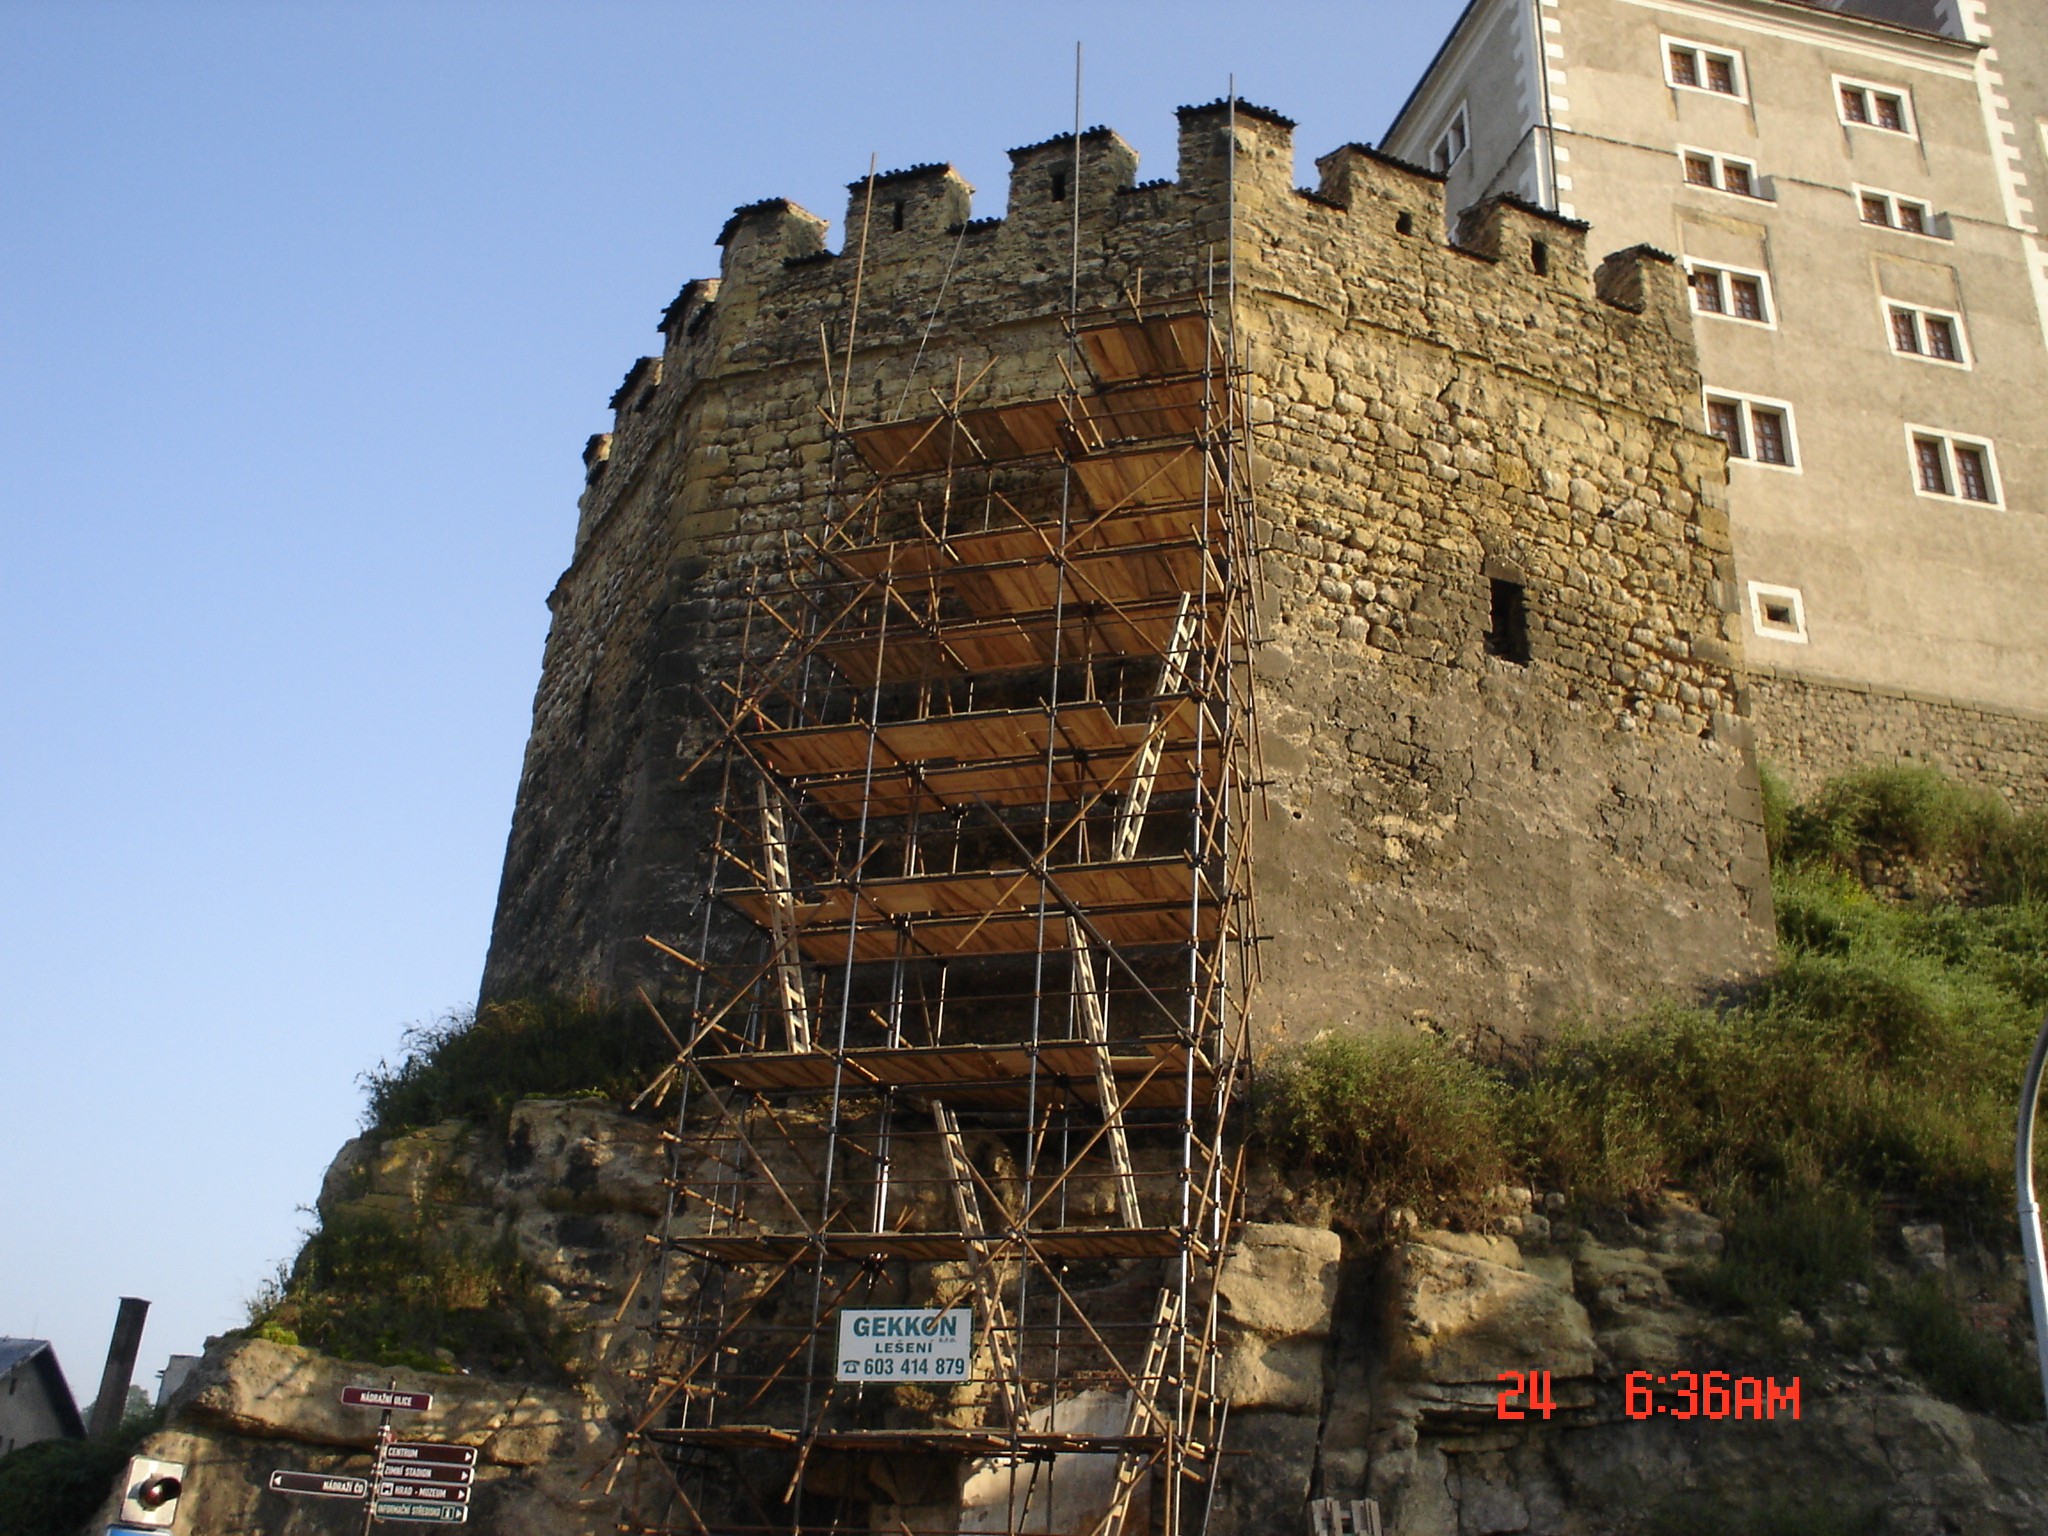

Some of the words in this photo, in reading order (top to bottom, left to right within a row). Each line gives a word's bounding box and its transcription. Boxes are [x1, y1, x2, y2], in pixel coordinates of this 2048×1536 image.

[853, 1316, 957, 1337] GEKKON
[875, 1339, 933, 1353] LEŠENÍ
[864, 1358, 894, 1375] 603
[900, 1358, 928, 1375] 414
[935, 1358, 965, 1375] 879
[388, 1447, 418, 1458] CENTRUM
[384, 1465, 404, 1476] ZIMNÍ
[404, 1467, 432, 1478] STADION
[394, 1485, 413, 1496] HRAD
[419, 1487, 447, 1498] MUZEUM
